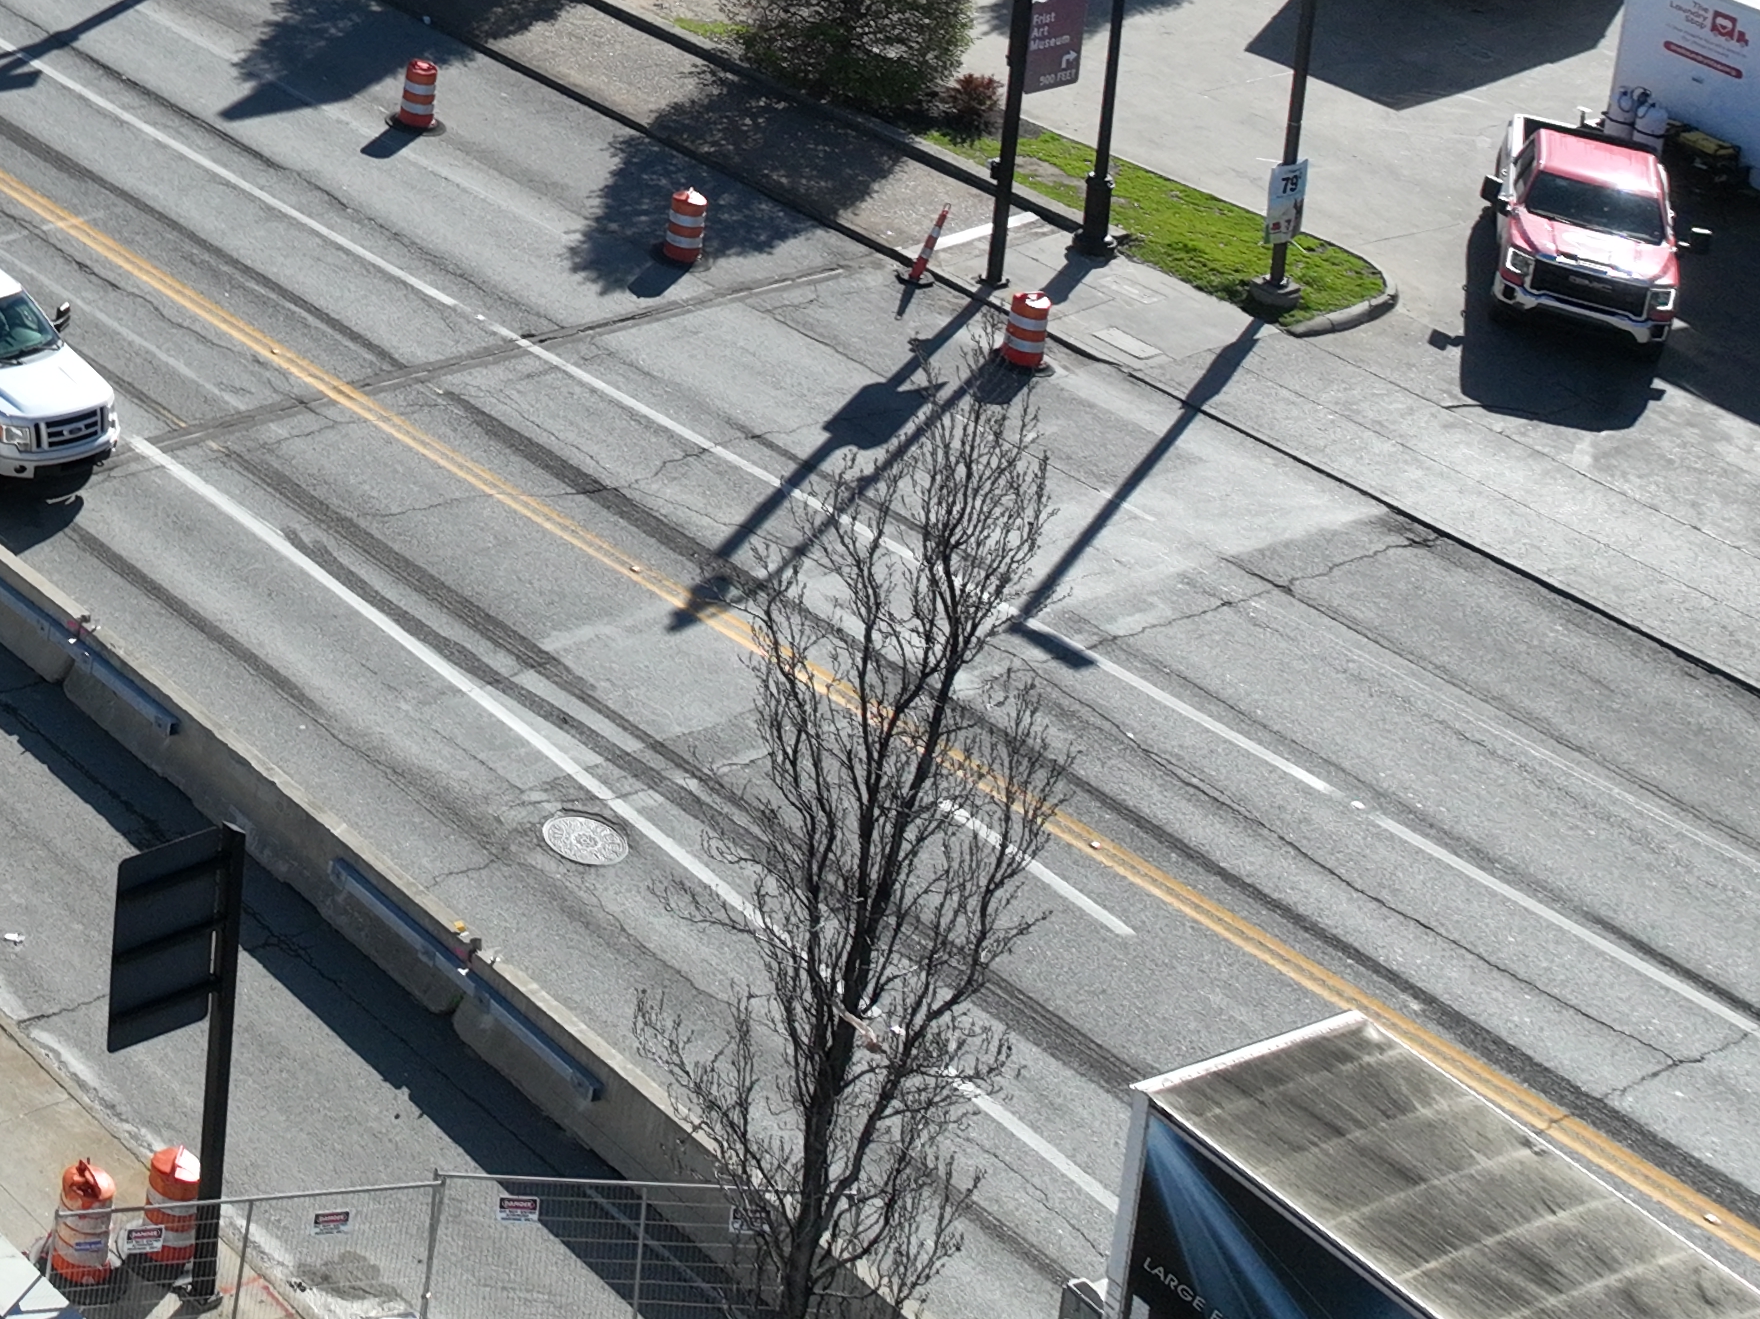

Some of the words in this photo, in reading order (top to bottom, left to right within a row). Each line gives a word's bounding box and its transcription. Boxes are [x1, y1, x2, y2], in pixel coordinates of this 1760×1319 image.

[1033, 12, 1056, 24] Frist
[1031, 26, 1049, 39] Art
[1029, 34, 1071, 51] Museum
[1057, 69, 1077, 81] FEET
[1142, 1256, 1207, 1313] LARGE
